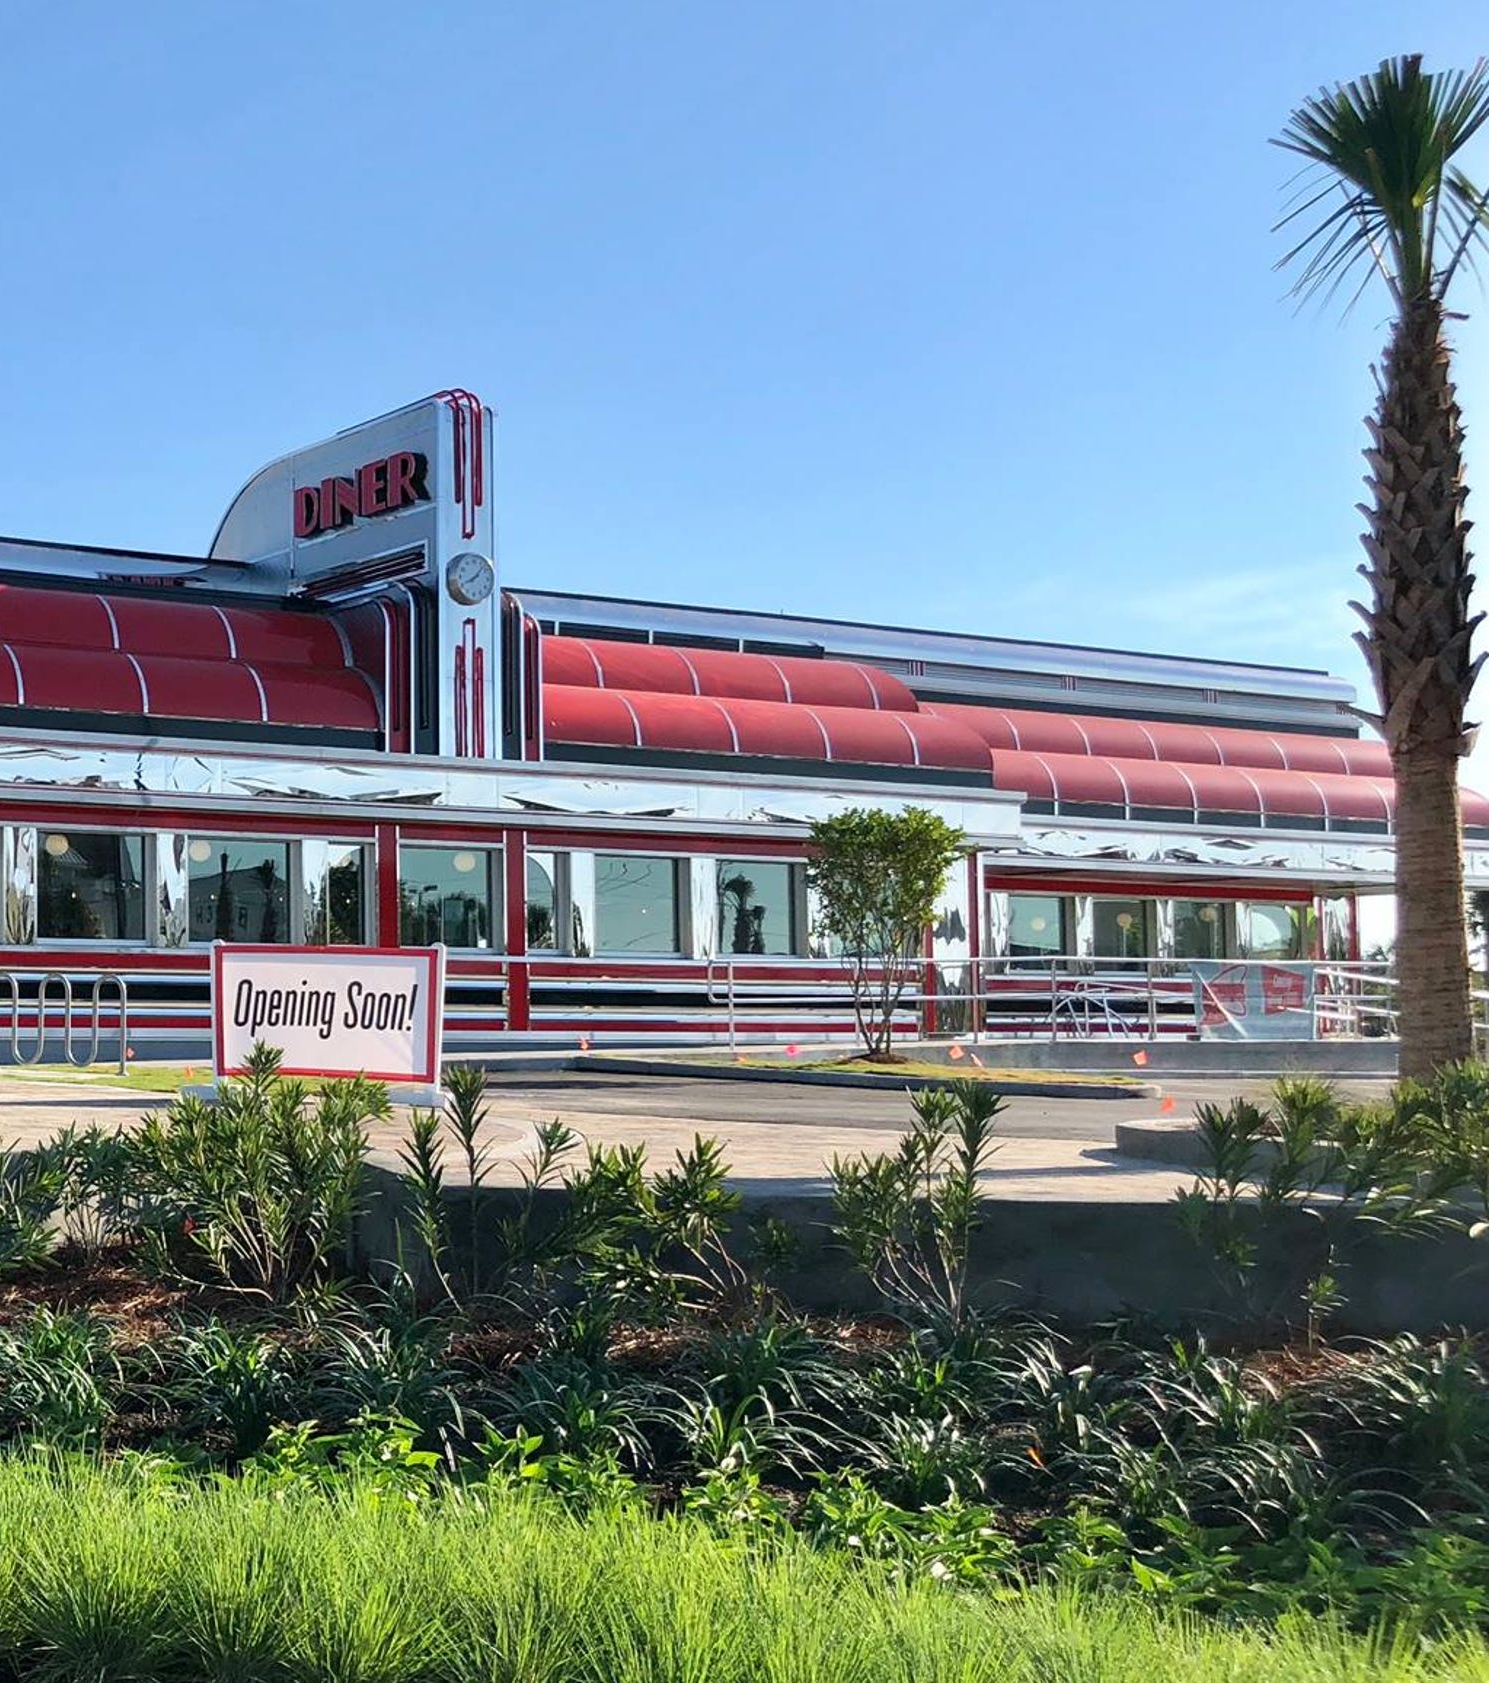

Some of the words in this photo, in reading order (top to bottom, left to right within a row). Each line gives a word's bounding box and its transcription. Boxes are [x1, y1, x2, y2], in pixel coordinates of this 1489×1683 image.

[294, 451, 428, 538] DINER
[233, 978, 337, 1040] Opening
[343, 980, 419, 1032] Soon!
